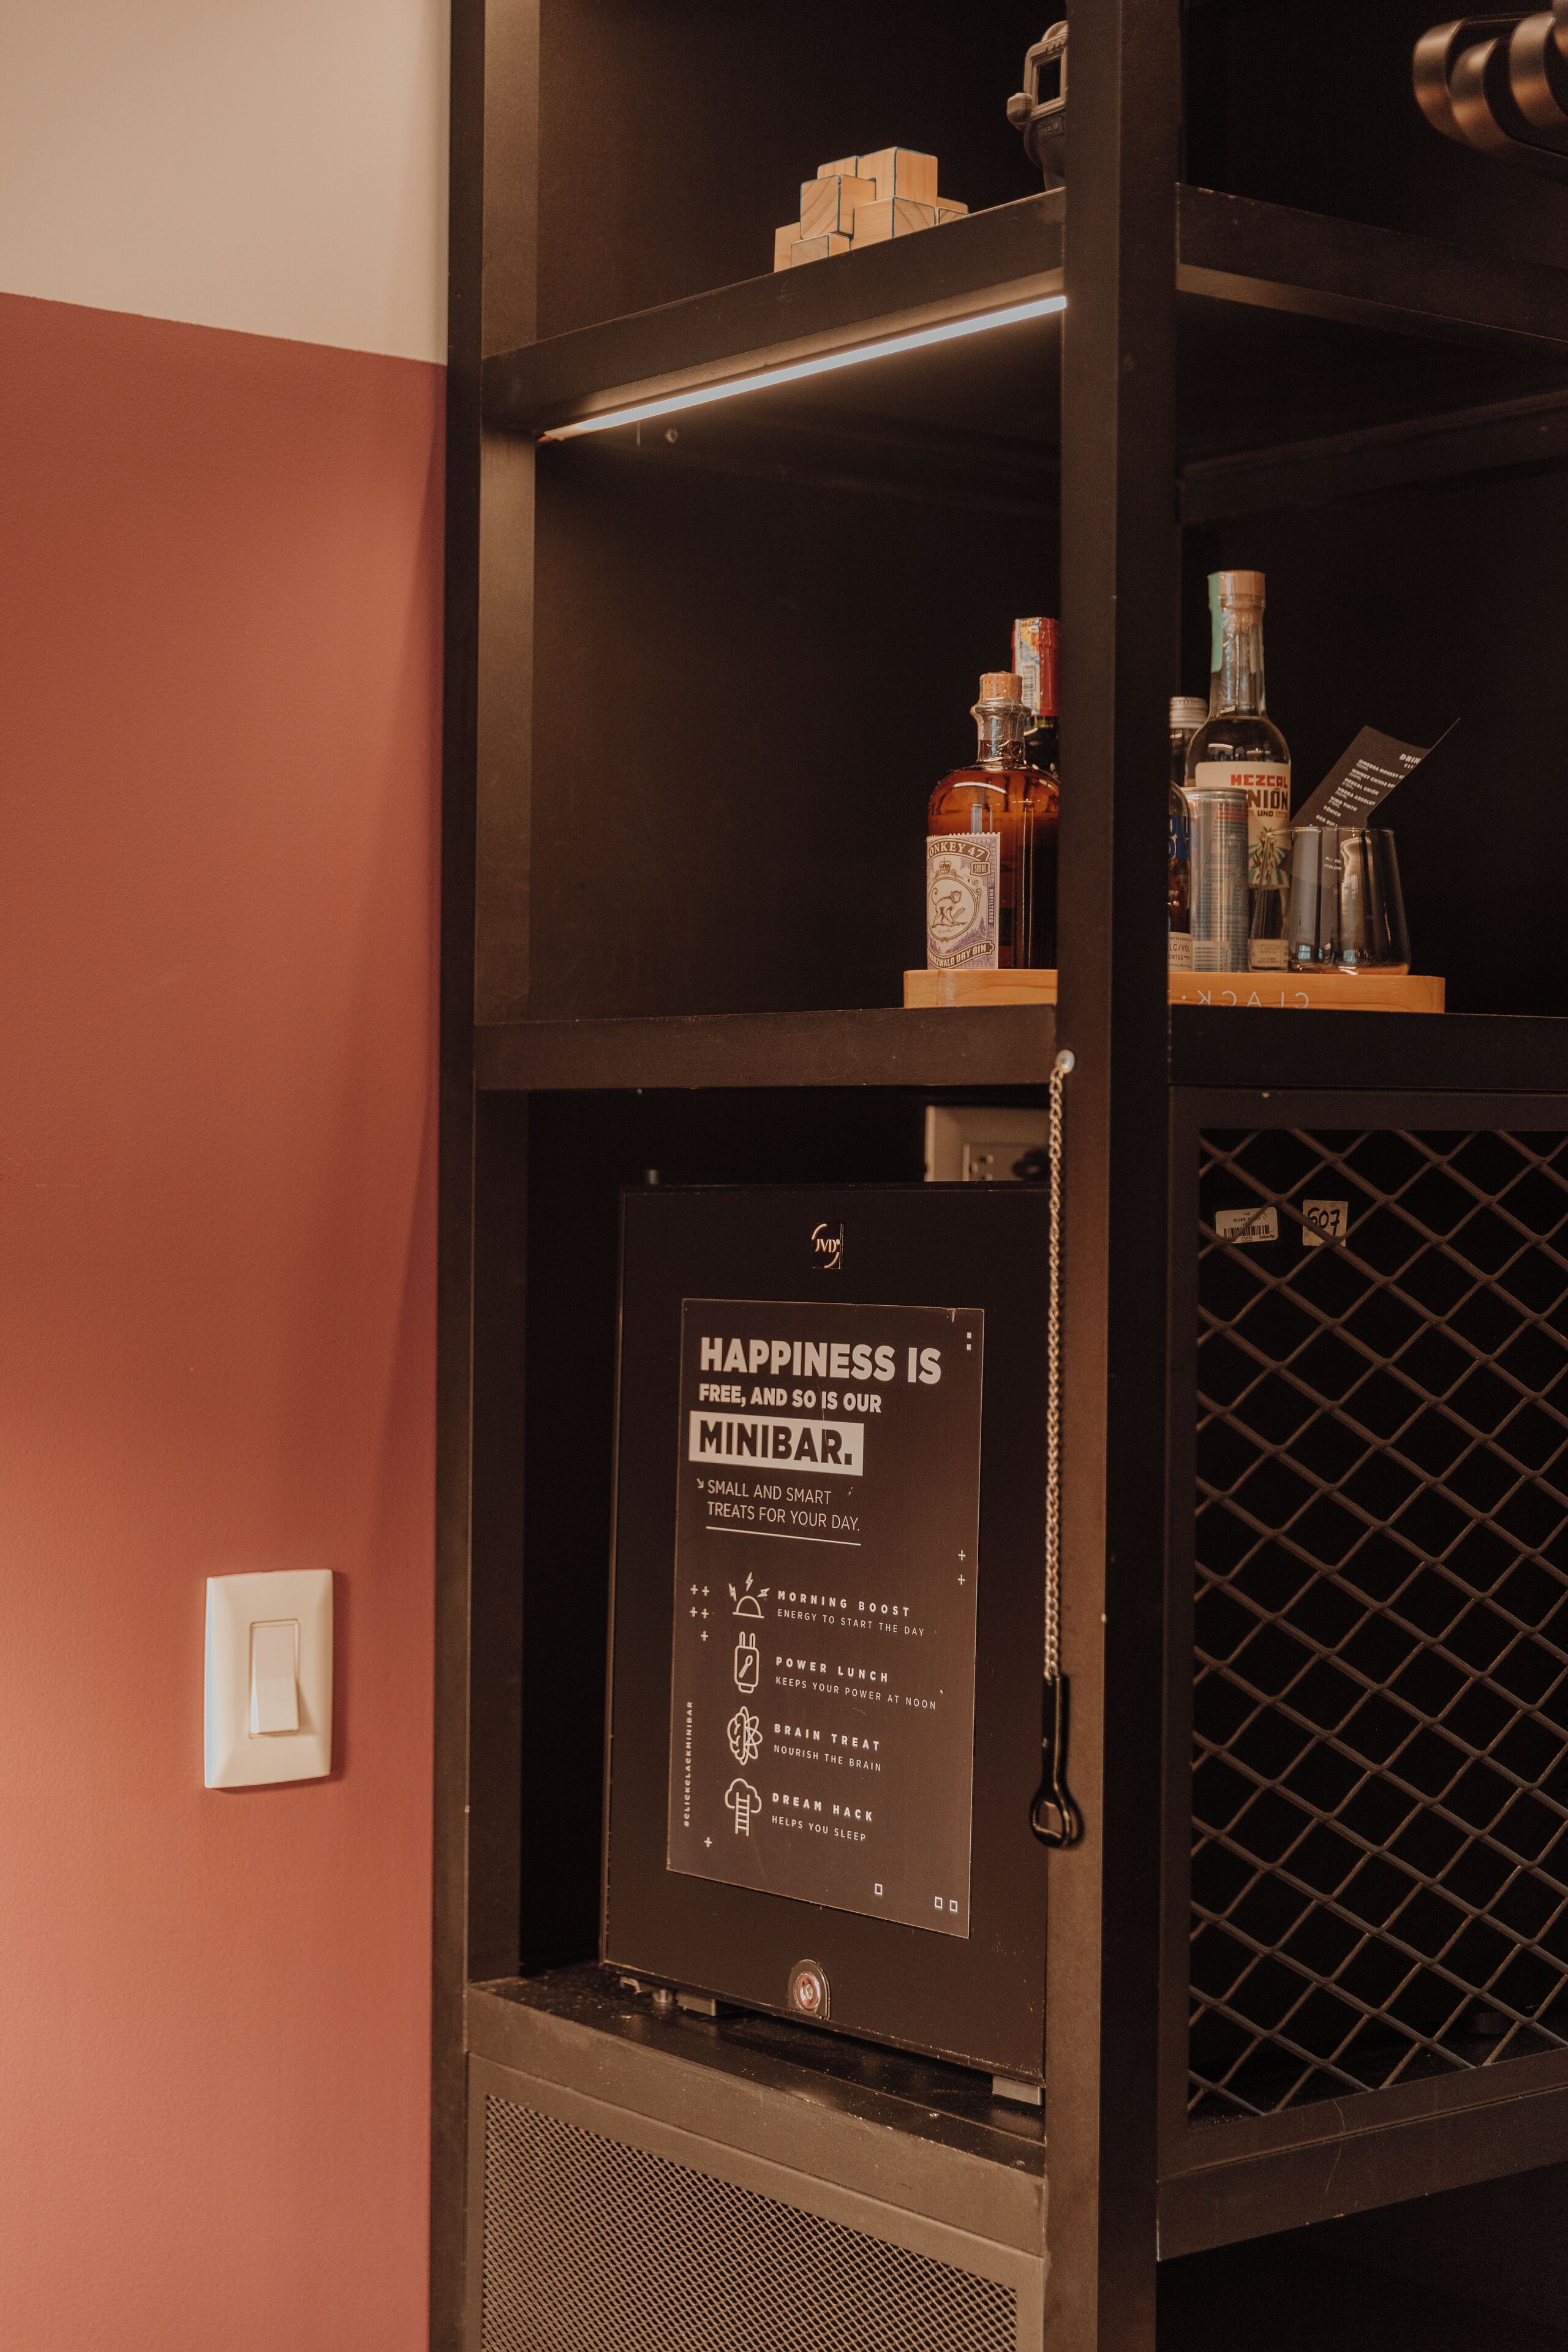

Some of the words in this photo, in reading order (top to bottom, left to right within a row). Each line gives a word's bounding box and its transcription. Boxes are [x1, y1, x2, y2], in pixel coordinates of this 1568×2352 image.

[1248, 788, 1289, 811] NIÓN
[929, 842, 967, 857] ONKEY
[968, 846, 985, 859] 47
[956, 949, 971, 963] DRY
[972, 944, 987, 955] GIN
[1169, 943, 1190, 953] LC/VOL.
[700, 1336, 895, 1382] HAPPINESS
[907, 1347, 941, 1385] IS
[699, 1383, 746, 1408] FREE,
[750, 1387, 788, 1406] AND
[791, 1389, 816, 1408] SO
[821, 1391, 838, 1410] IS
[843, 1392, 882, 1413] OUR
[699, 1420, 853, 1466] MINIBAR.
[707, 1479, 750, 1497] SMALL
[753, 1484, 782, 1500] AND
[786, 1487, 832, 1505] SMART
[707, 1501, 755, 1520] TREATS
[759, 1507, 786, 1523] FOR
[790, 1510, 827, 1528] YOUR
[832, 1514, 860, 1531] DAY.
[777, 1590, 847, 1608] MORNING
[858, 1600, 909, 1617] BOOST
[777, 1608, 817, 1621] ENERGY
[823, 1615, 835, 1624] TO
[840, 1617, 873, 1629] START
[878, 1622, 898, 1633] THE
[904, 1626, 924, 1637] DAY
[775, 1656, 826, 1673] POWER
[837, 1665, 888, 1683] LUNCH
[775, 1676, 807, 1689] KEEPS
[812, 1682, 839, 1694] YOUR
[845, 1687, 881, 1701] POWER
[887, 1694, 900, 1703] AT
[905, 1697, 936, 1709] NOON
[774, 1723, 820, 1741] BRAIN
[831, 1733, 880, 1751] TREAT
[684, 1702, 693, 1827] #CLICKCLACKMINIBAR
[774, 1744, 818, 1760] NOURISH
[824, 1753, 843, 1765] THE
[849, 1758, 881, 1772] BRAIN
[772, 1792, 822, 1811] DREAM
[832, 1804, 872, 1822] HACK
[772, 1815, 803, 1829] HELPS
[809, 1822, 828, 1834] YOU
[834, 1828, 865, 1841] SLEEP
